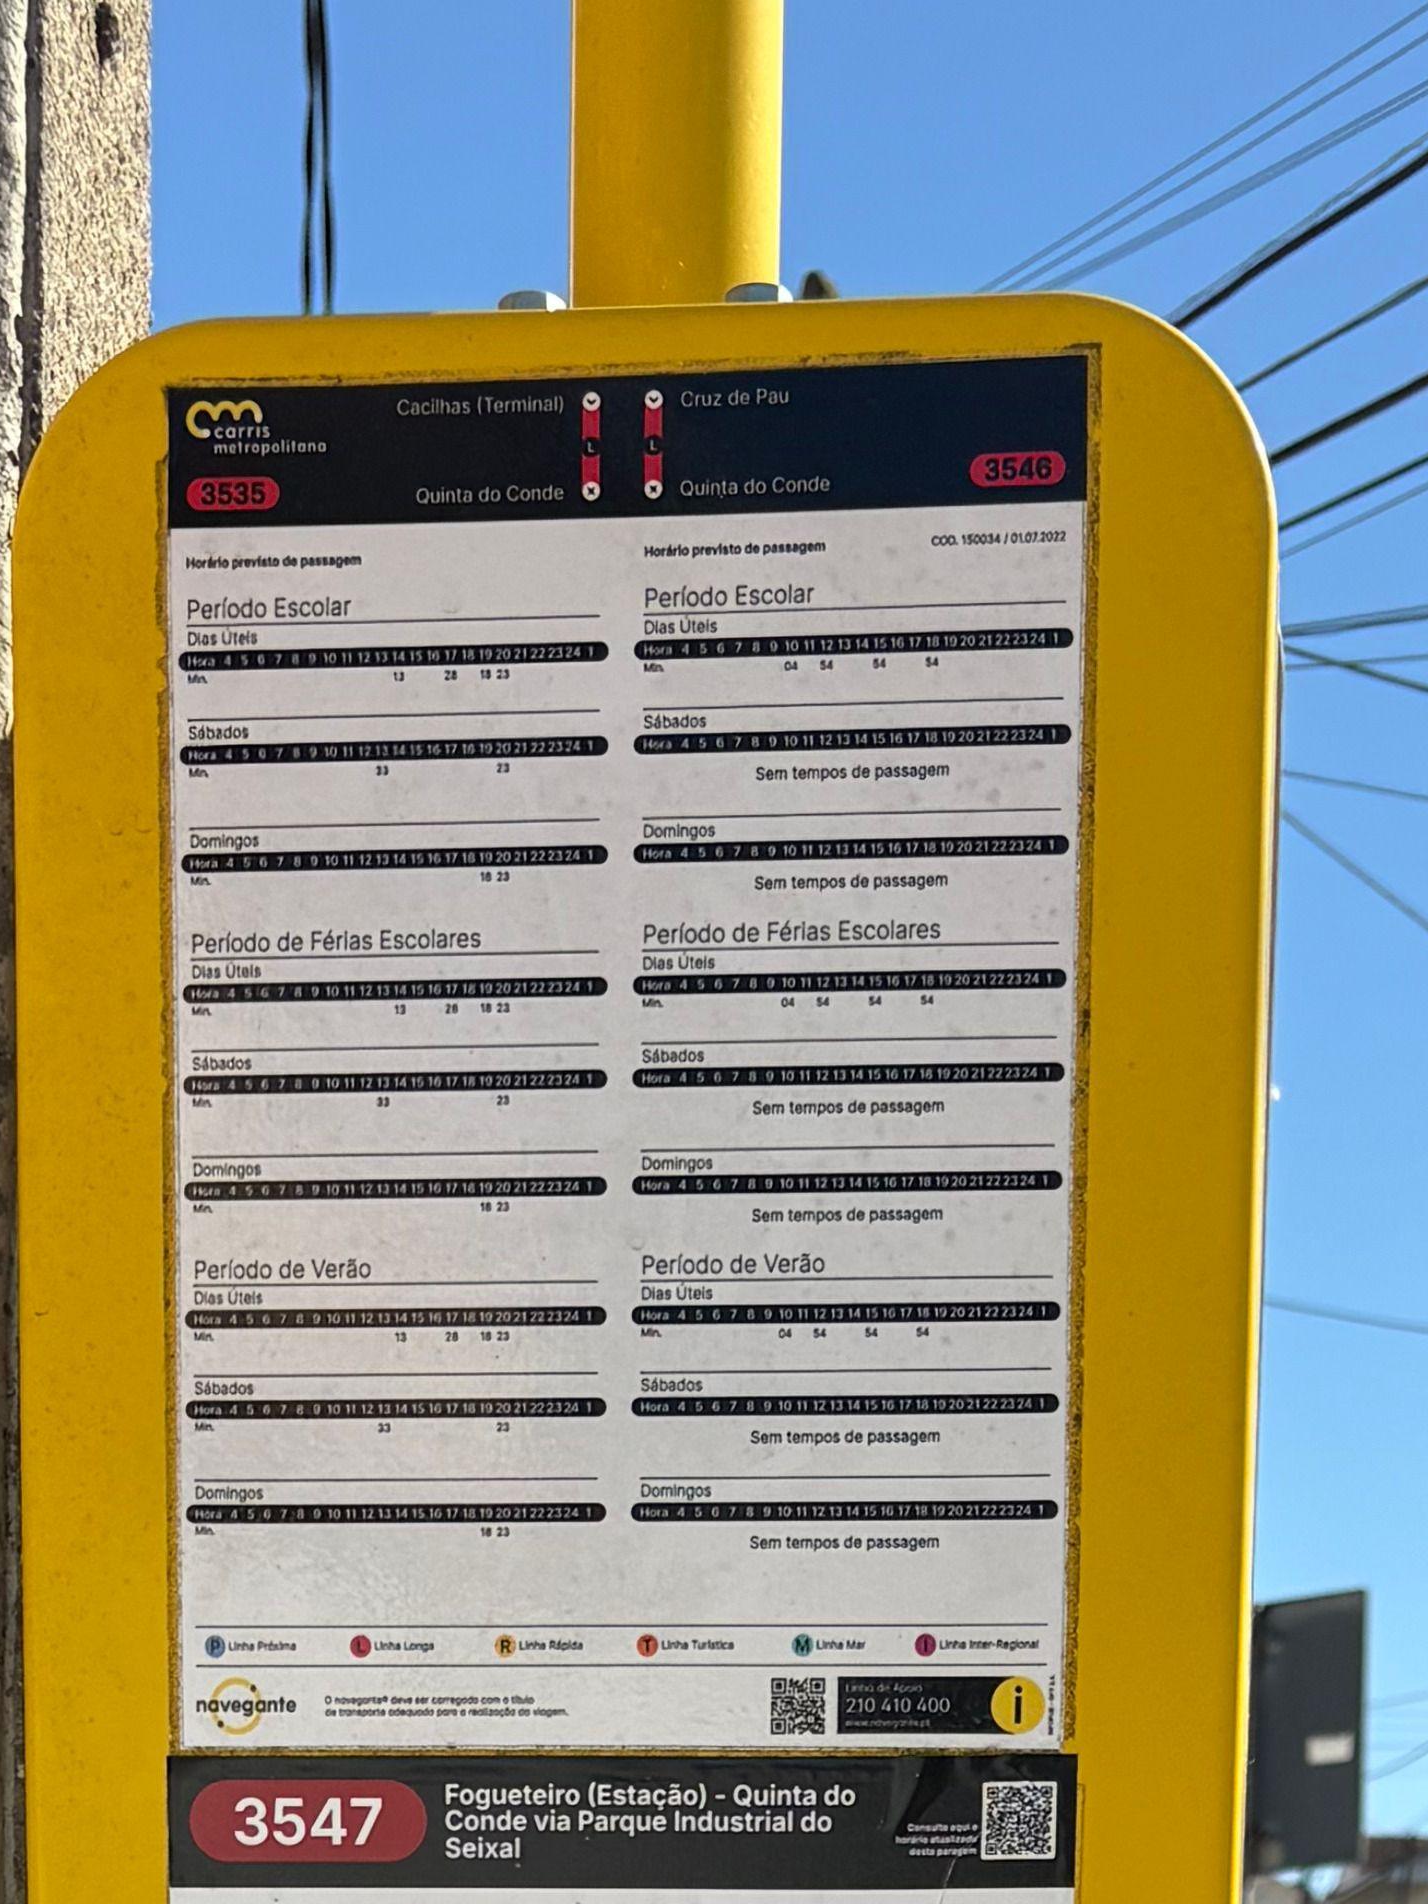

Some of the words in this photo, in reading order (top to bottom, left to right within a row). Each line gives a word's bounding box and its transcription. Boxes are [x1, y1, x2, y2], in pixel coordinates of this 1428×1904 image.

[397, 398, 470, 416] Cacilhas
[478, 395, 563, 414] (Terminal)
[681, 390, 721, 407] Cruz
[728, 389, 750, 406] de
[757, 388, 788, 405] Pau
[214, 426, 270, 439] carris
[214, 439, 326, 456] metropolitana
[985, 456, 1057, 482] 3546
[200, 483, 268, 506] 3535
[416, 487, 472, 504] Quinta
[479, 486, 501, 502] do
[506, 484, 564, 502] Conde
[680, 479, 738, 498] Quinta
[744, 478, 766, 495] do
[772, 476, 830, 494] Conde
[645, 585, 727, 608] Período
[736, 584, 814, 606] Escolar
[644, 619, 675, 635] Dias
[680, 616, 717, 634] Úteis
[644, 714, 706, 730] Sábados
[756, 766, 787, 781] Sem
[792, 766, 847, 781] tempos
[852, 765, 870, 779] de
[875, 765, 949, 780] passagem
[643, 824, 715, 841] Domingos
[644, 922, 725, 945] Período
[732, 923, 759, 943] de
[768, 920, 831, 942] Férias
[839, 920, 940, 941] Escolares
[643, 1254, 723, 1275] Período
[730, 1254, 757, 1274] de
[764, 1253, 825, 1274] Verão
[196, 1697, 296, 1718] navegante
[846, 1697, 875, 1713] 210
[881, 1697, 911, 1713] 410
[917, 1697, 950, 1713] 400
[445, 1783, 580, 1811] Fogueteiro
[588, 1782, 706, 1810] (Estação)
[733, 1784, 816, 1807] Quinta
[824, 1785, 855, 1807] do
[235, 1797, 382, 1846] 3547
[445, 1806, 527, 1831] Conde
[534, 1809, 570, 1831] via
[579, 1806, 667, 1836] Parque
[675, 1807, 793, 1832] Industrial
[801, 1810, 832, 1832] do
[446, 1837, 520, 1859] Seixal
